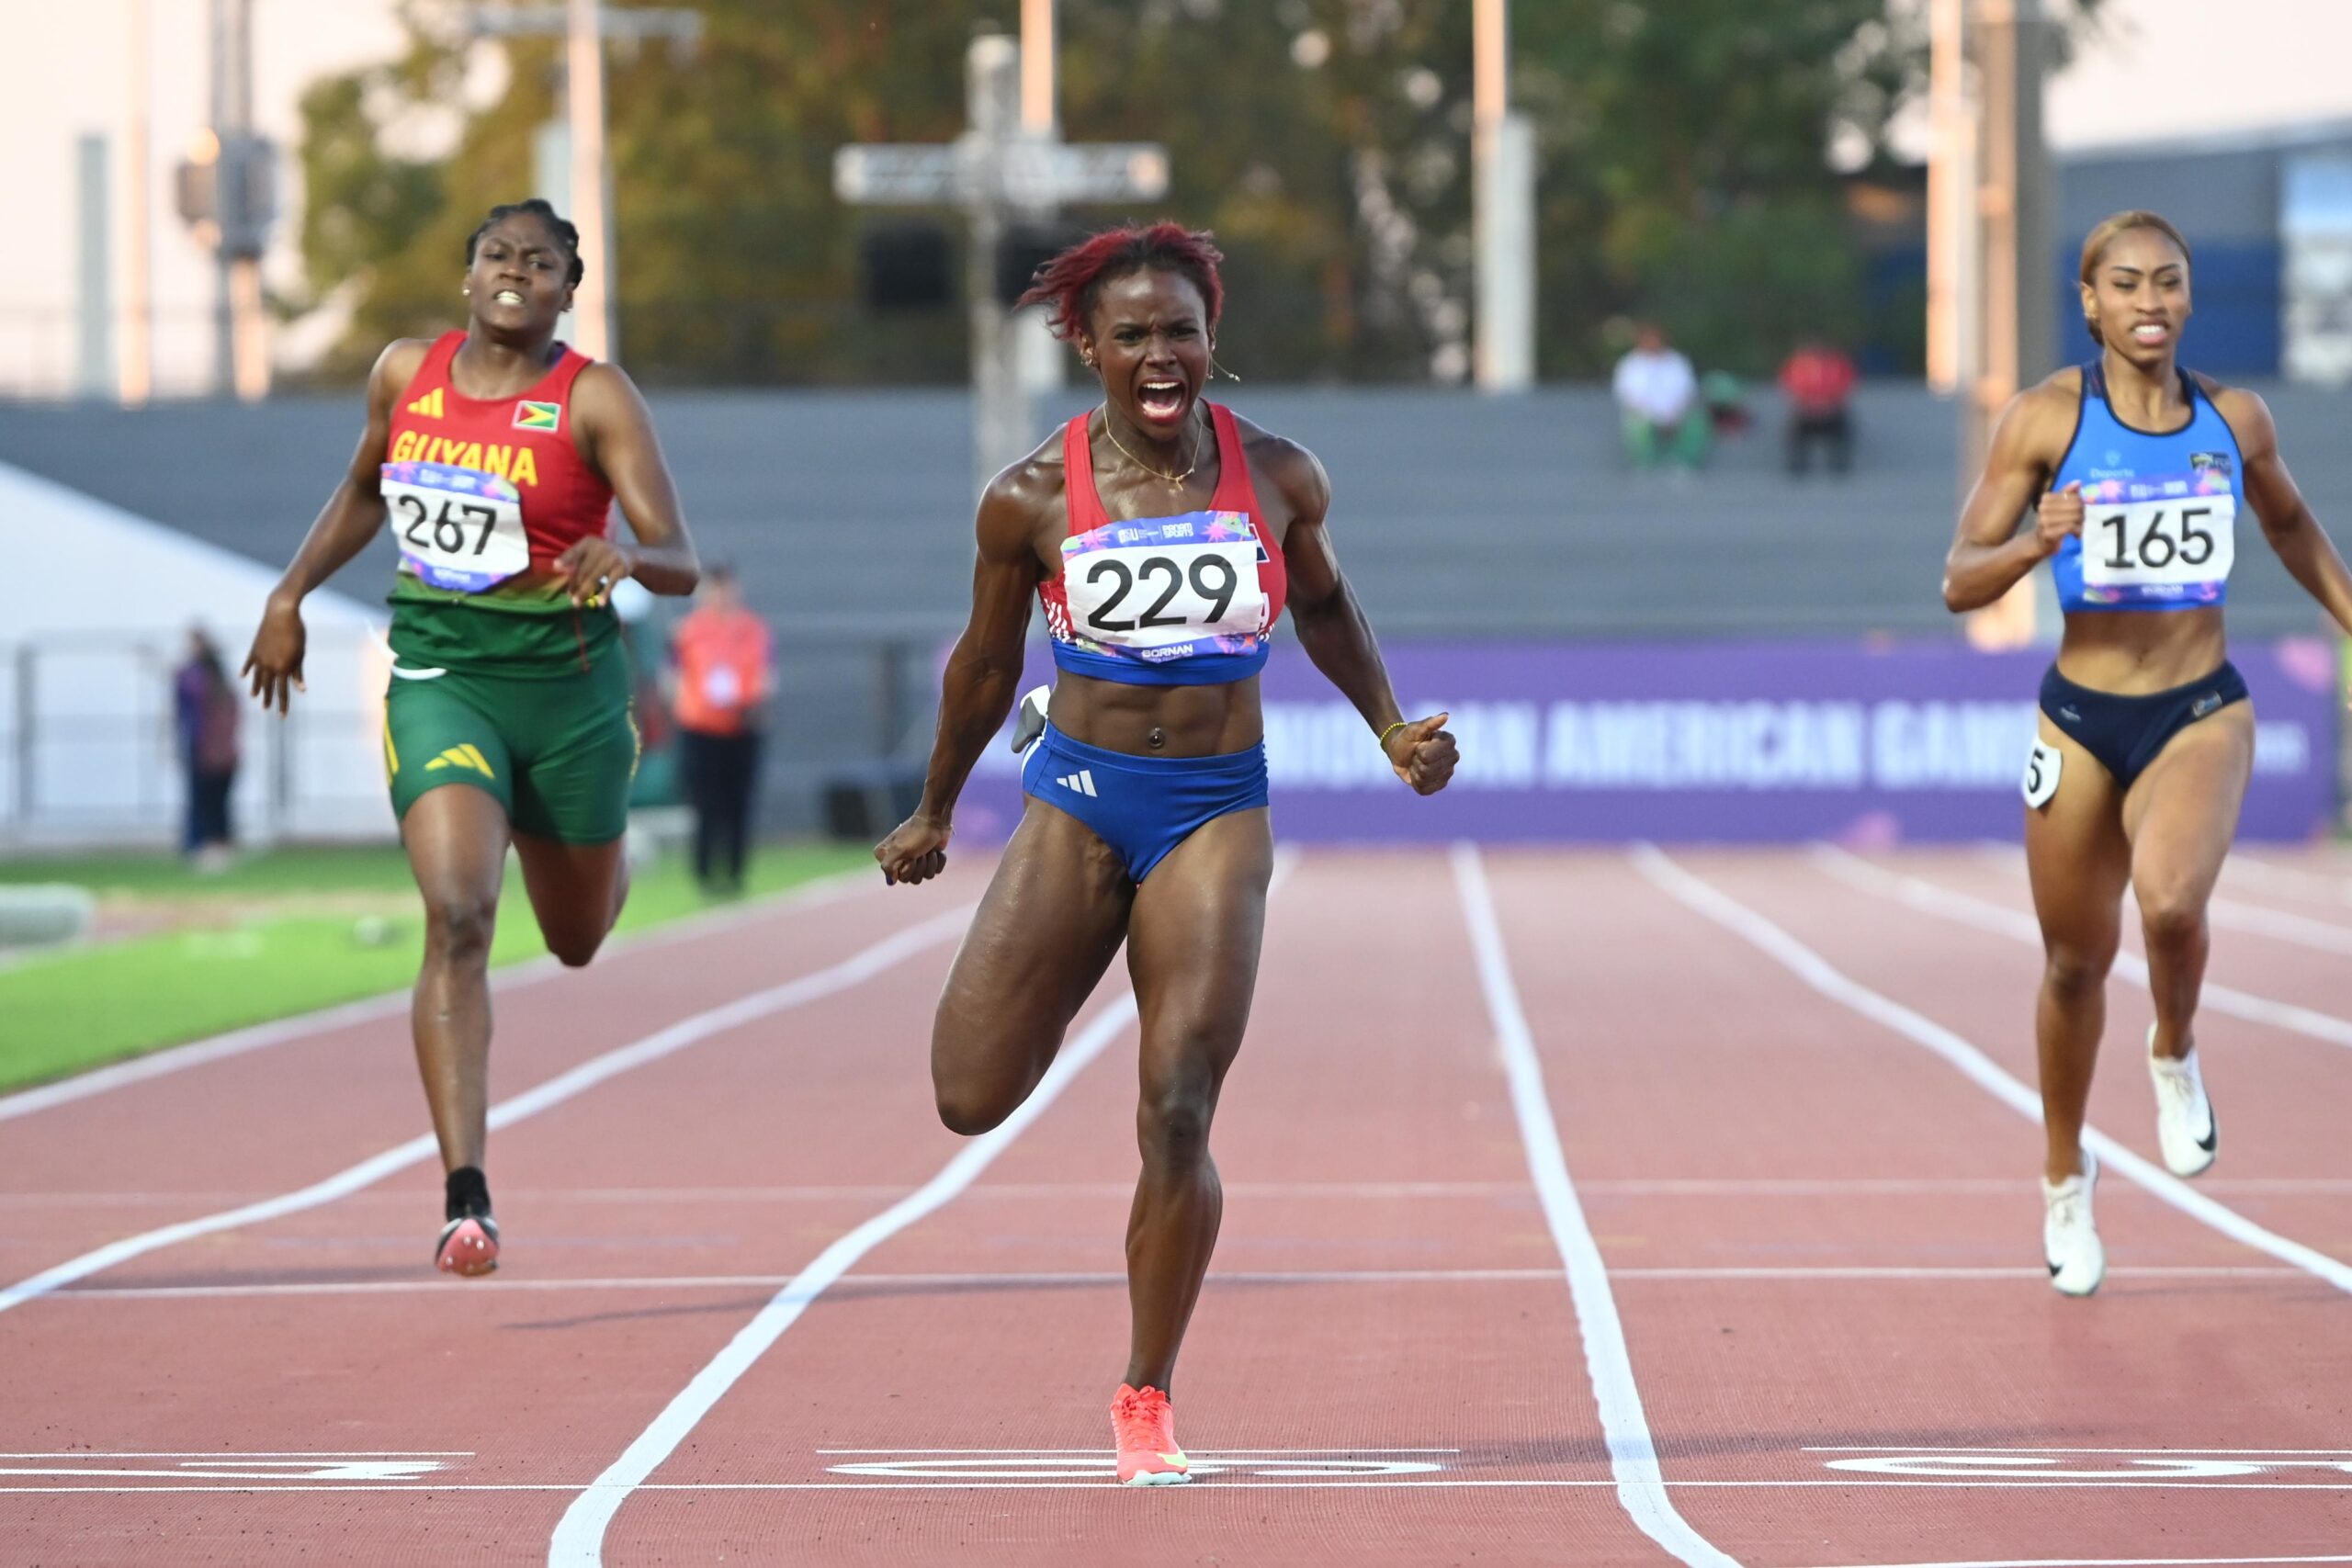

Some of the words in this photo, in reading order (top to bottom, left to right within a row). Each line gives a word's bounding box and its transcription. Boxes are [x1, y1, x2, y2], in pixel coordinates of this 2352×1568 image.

[391, 430, 538, 486] GUYANA
[400, 495, 498, 556] 267
[2102, 508, 2214, 569] 165
[1087, 553, 1238, 632] 229
[1872, 700, 2039, 789] GAM
[2027, 747, 2045, 794] 5
